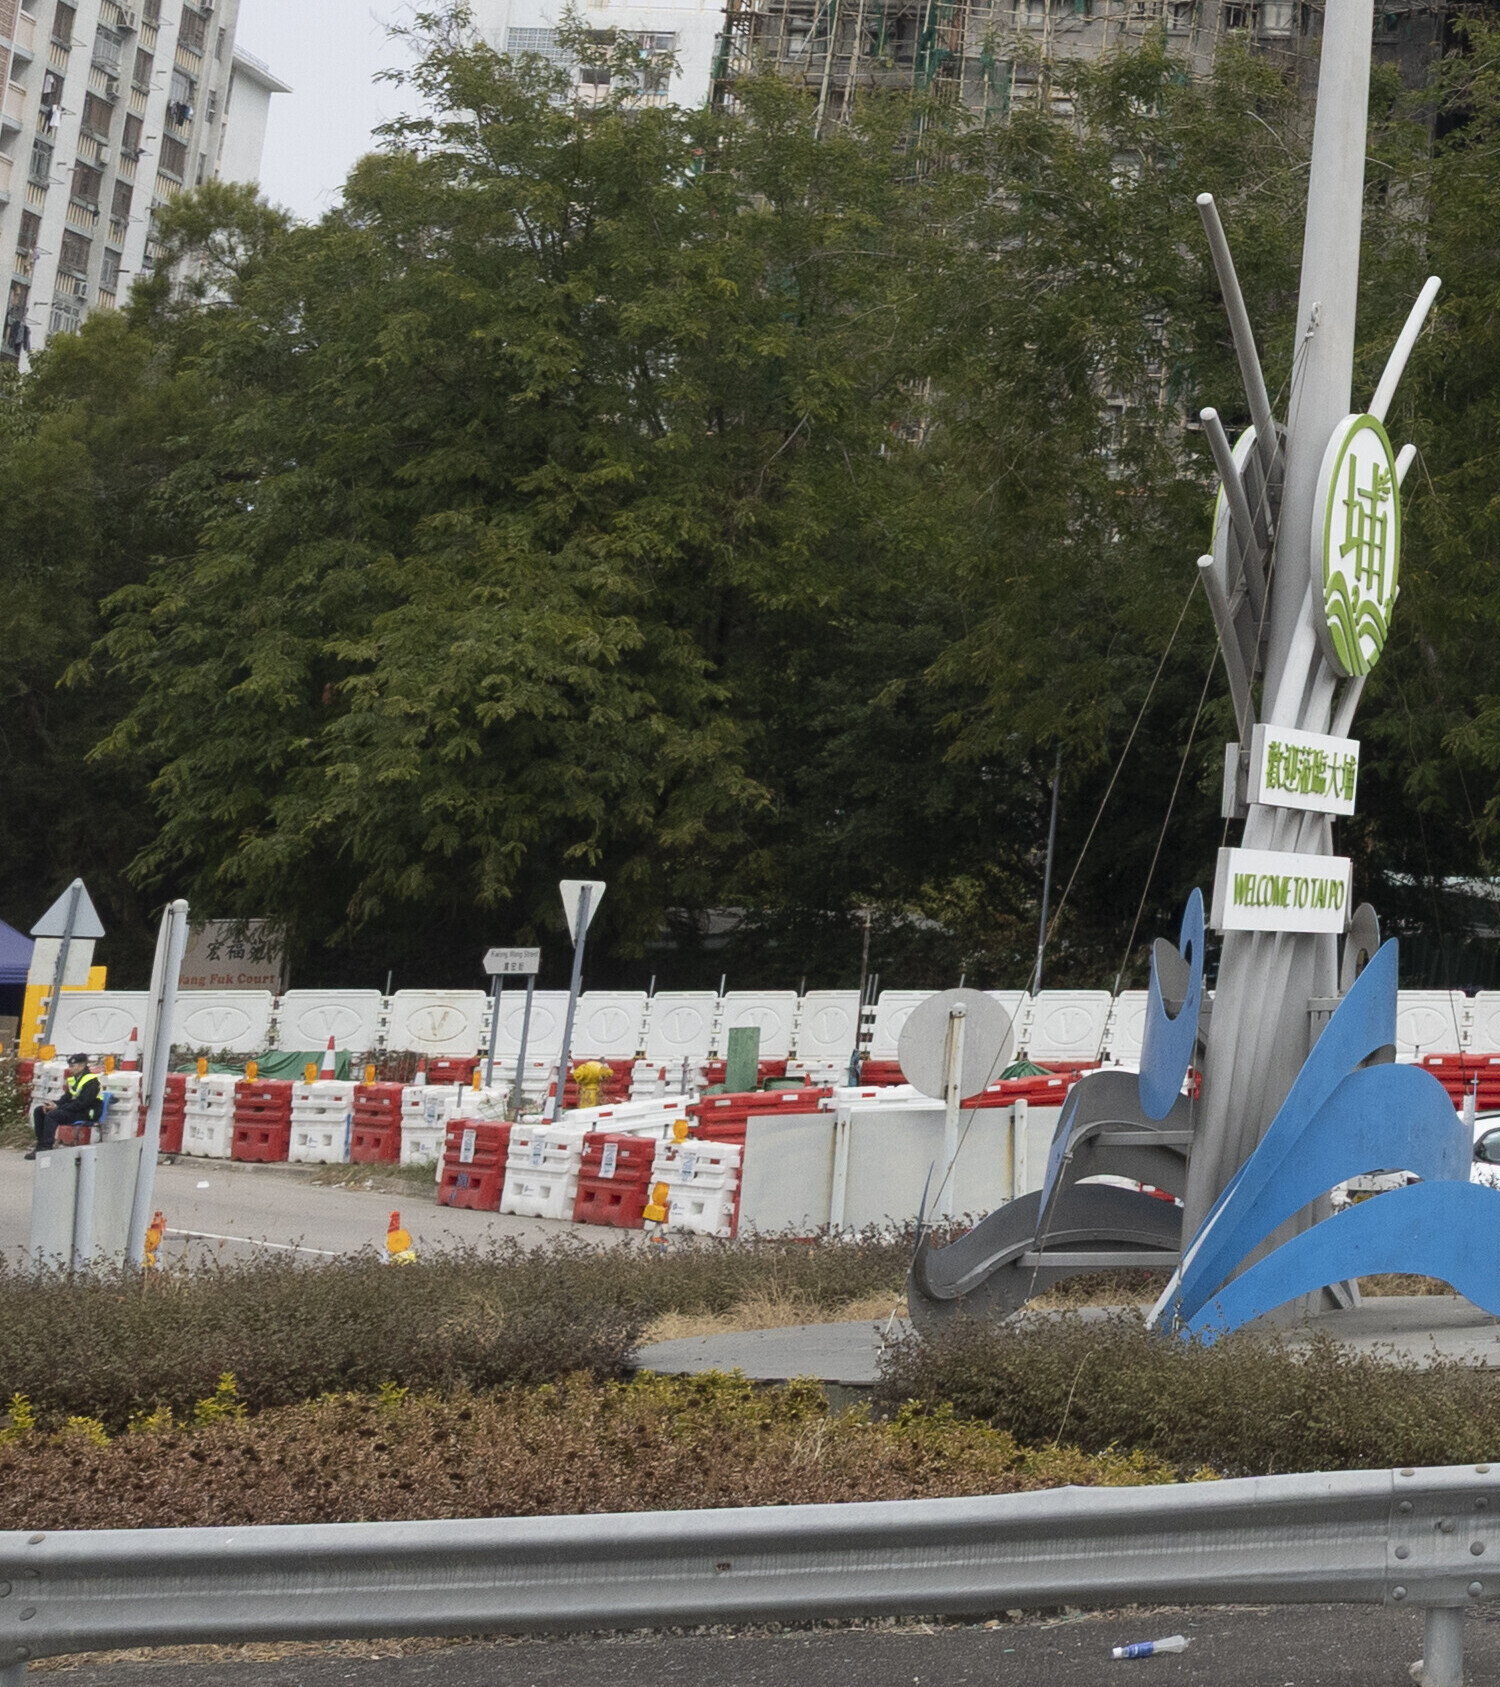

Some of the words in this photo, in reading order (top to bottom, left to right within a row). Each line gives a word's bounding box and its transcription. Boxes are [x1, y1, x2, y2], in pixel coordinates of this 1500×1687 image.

[1233, 872, 1293, 909] WELCOME
[1293, 876, 1310, 909] TO
[1328, 879, 1345, 912] PO
[179, 974, 206, 987] ang
[209, 973, 234, 985] Fuk
[237, 972, 276, 985] Court
